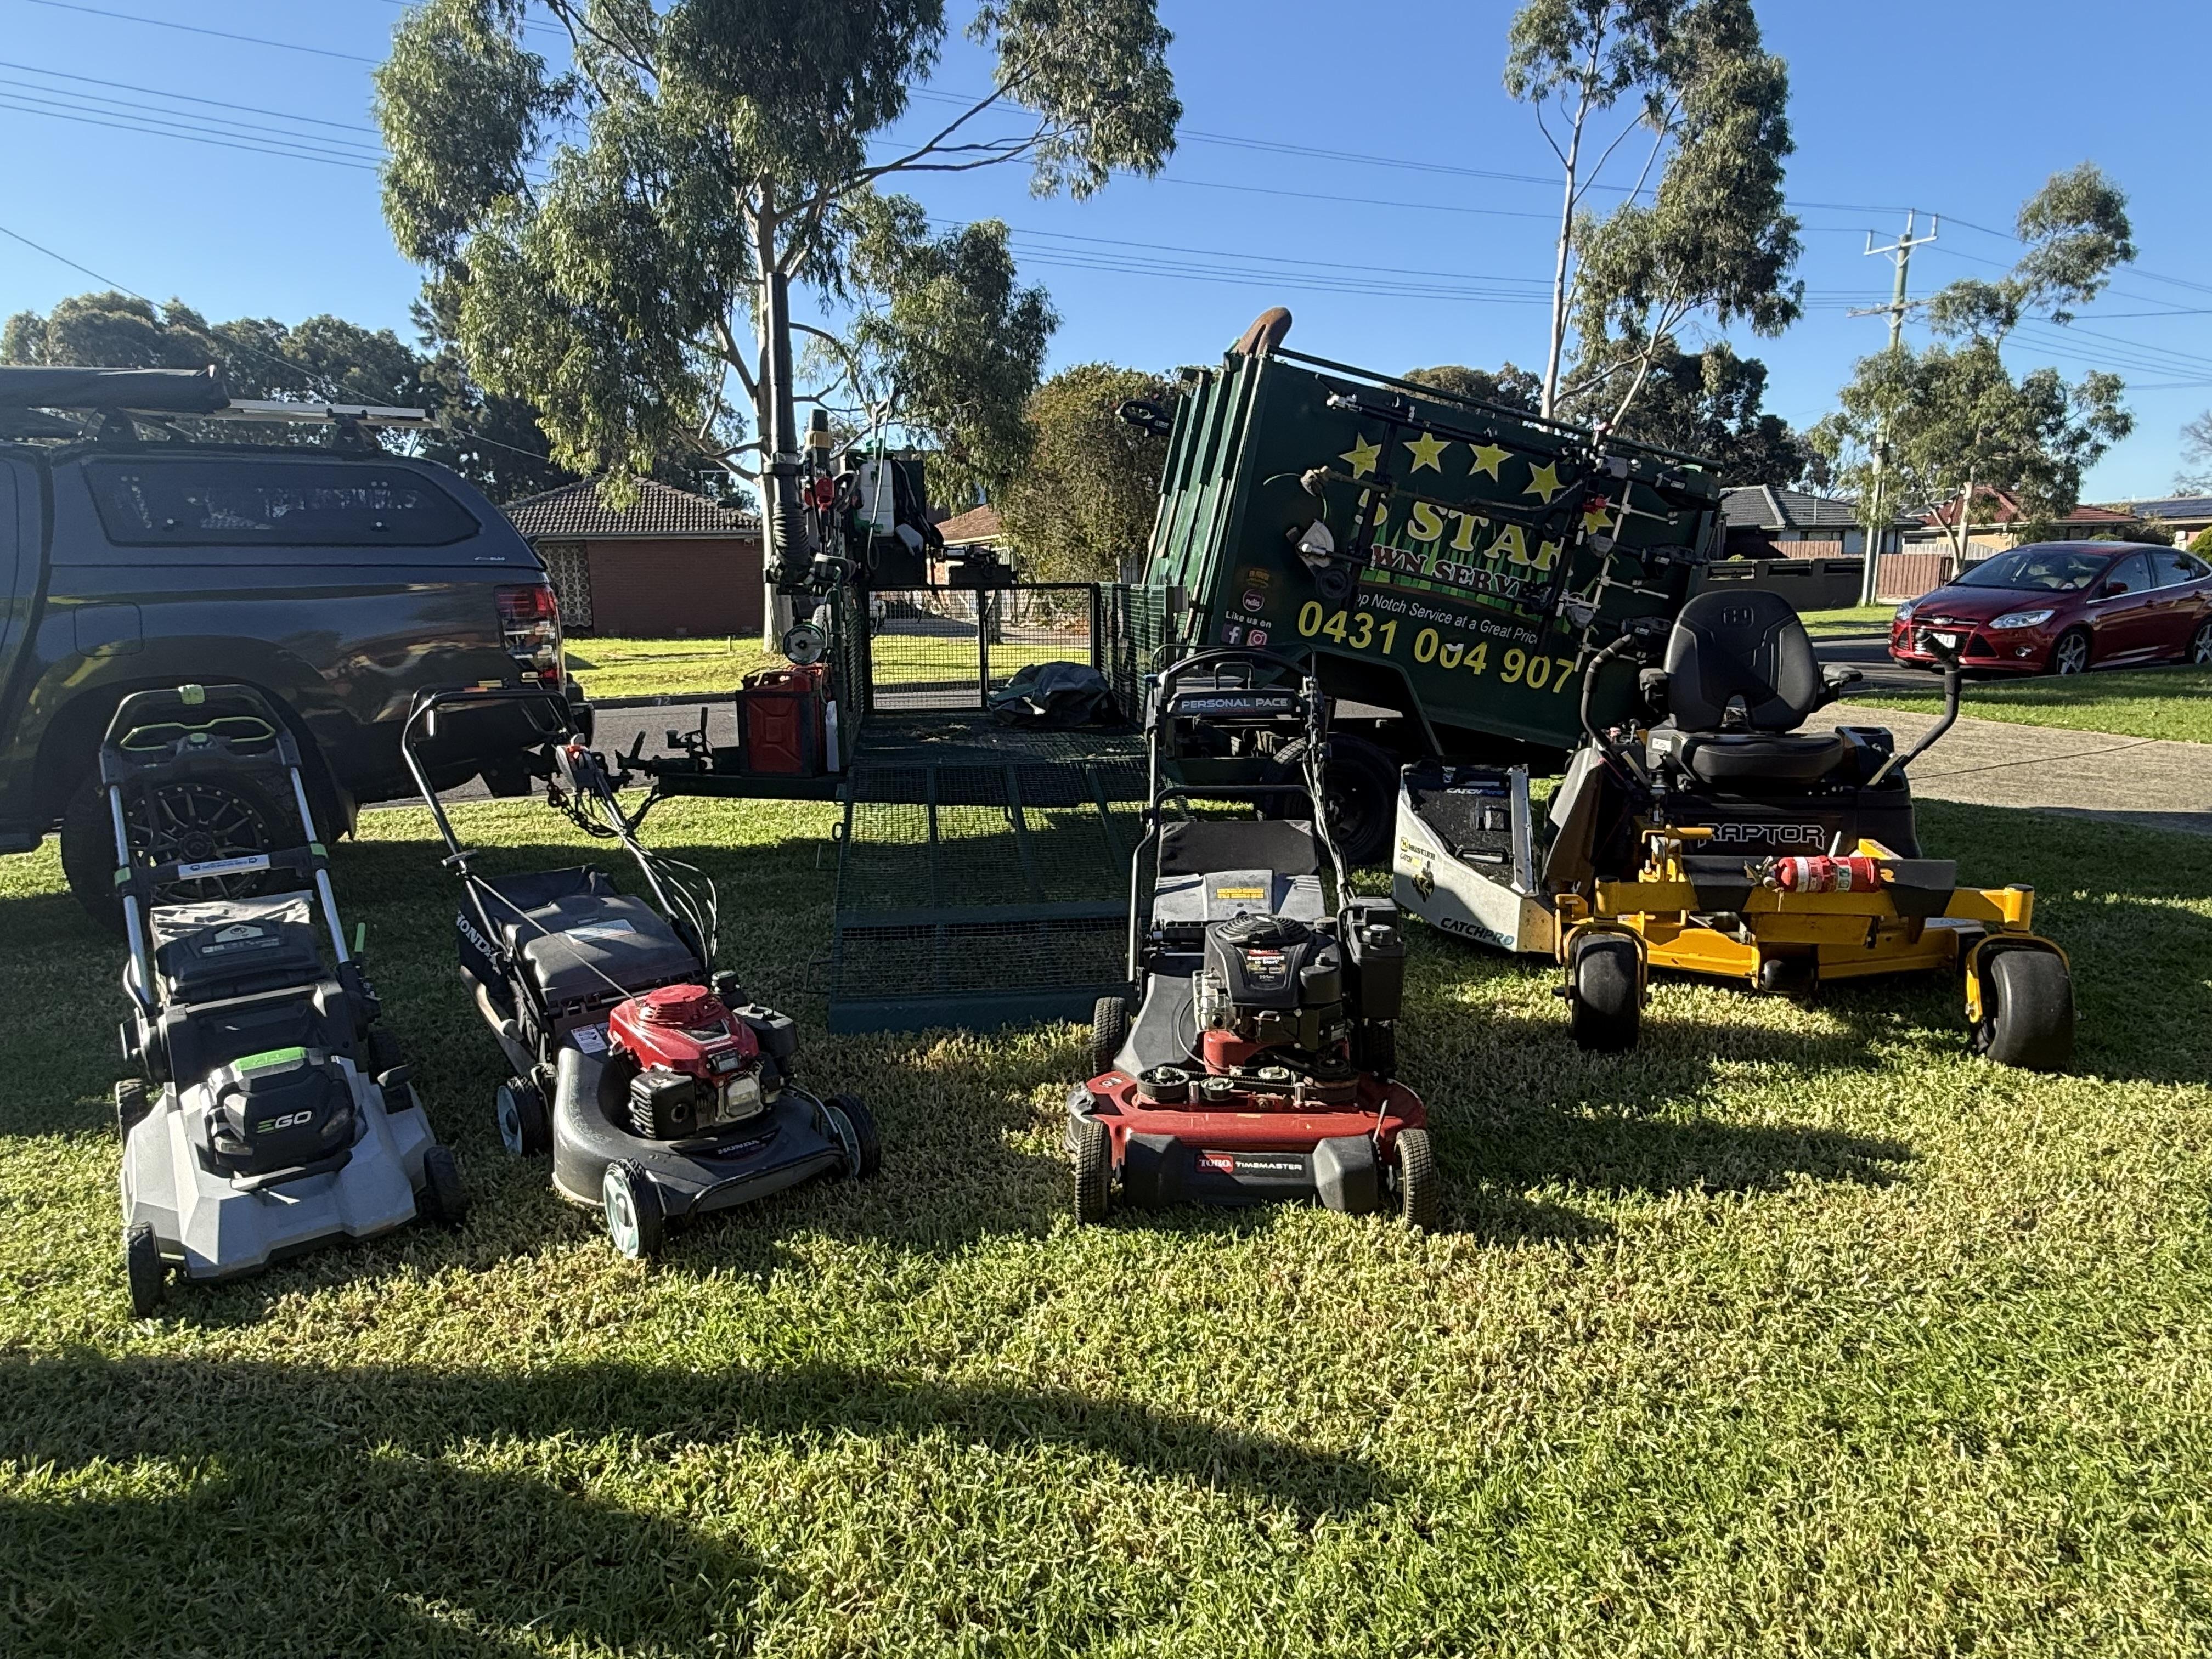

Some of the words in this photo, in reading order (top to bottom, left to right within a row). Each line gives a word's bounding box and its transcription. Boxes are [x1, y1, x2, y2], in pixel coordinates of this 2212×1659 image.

[1370, 543, 1429, 574] WN
[1225, 610, 1244, 622] Like
[1246, 617, 1257, 625] us
[1260, 620, 1272, 629] on
[1372, 594, 1407, 614] Notch
[1409, 603, 1453, 625] Service
[1454, 614, 1468, 628] at
[1469, 618, 1476, 630] a
[1481, 620, 1512, 640] Great
[1298, 601, 1398, 655] 0431
[1414, 628, 1489, 675] 004
[1500, 648, 1577, 693] 907
[1182, 698, 1251, 709] PERSONAL
[1255, 698, 1288, 707] PACE
[1697, 823, 1825, 850] RAPTOR
[1441, 918, 1515, 945] CATCHPRO
[257, 1110, 312, 1133] EGO
[1199, 1159, 1232, 1167] TORO
[1235, 1161, 1302, 1171] TIMEMASTER
